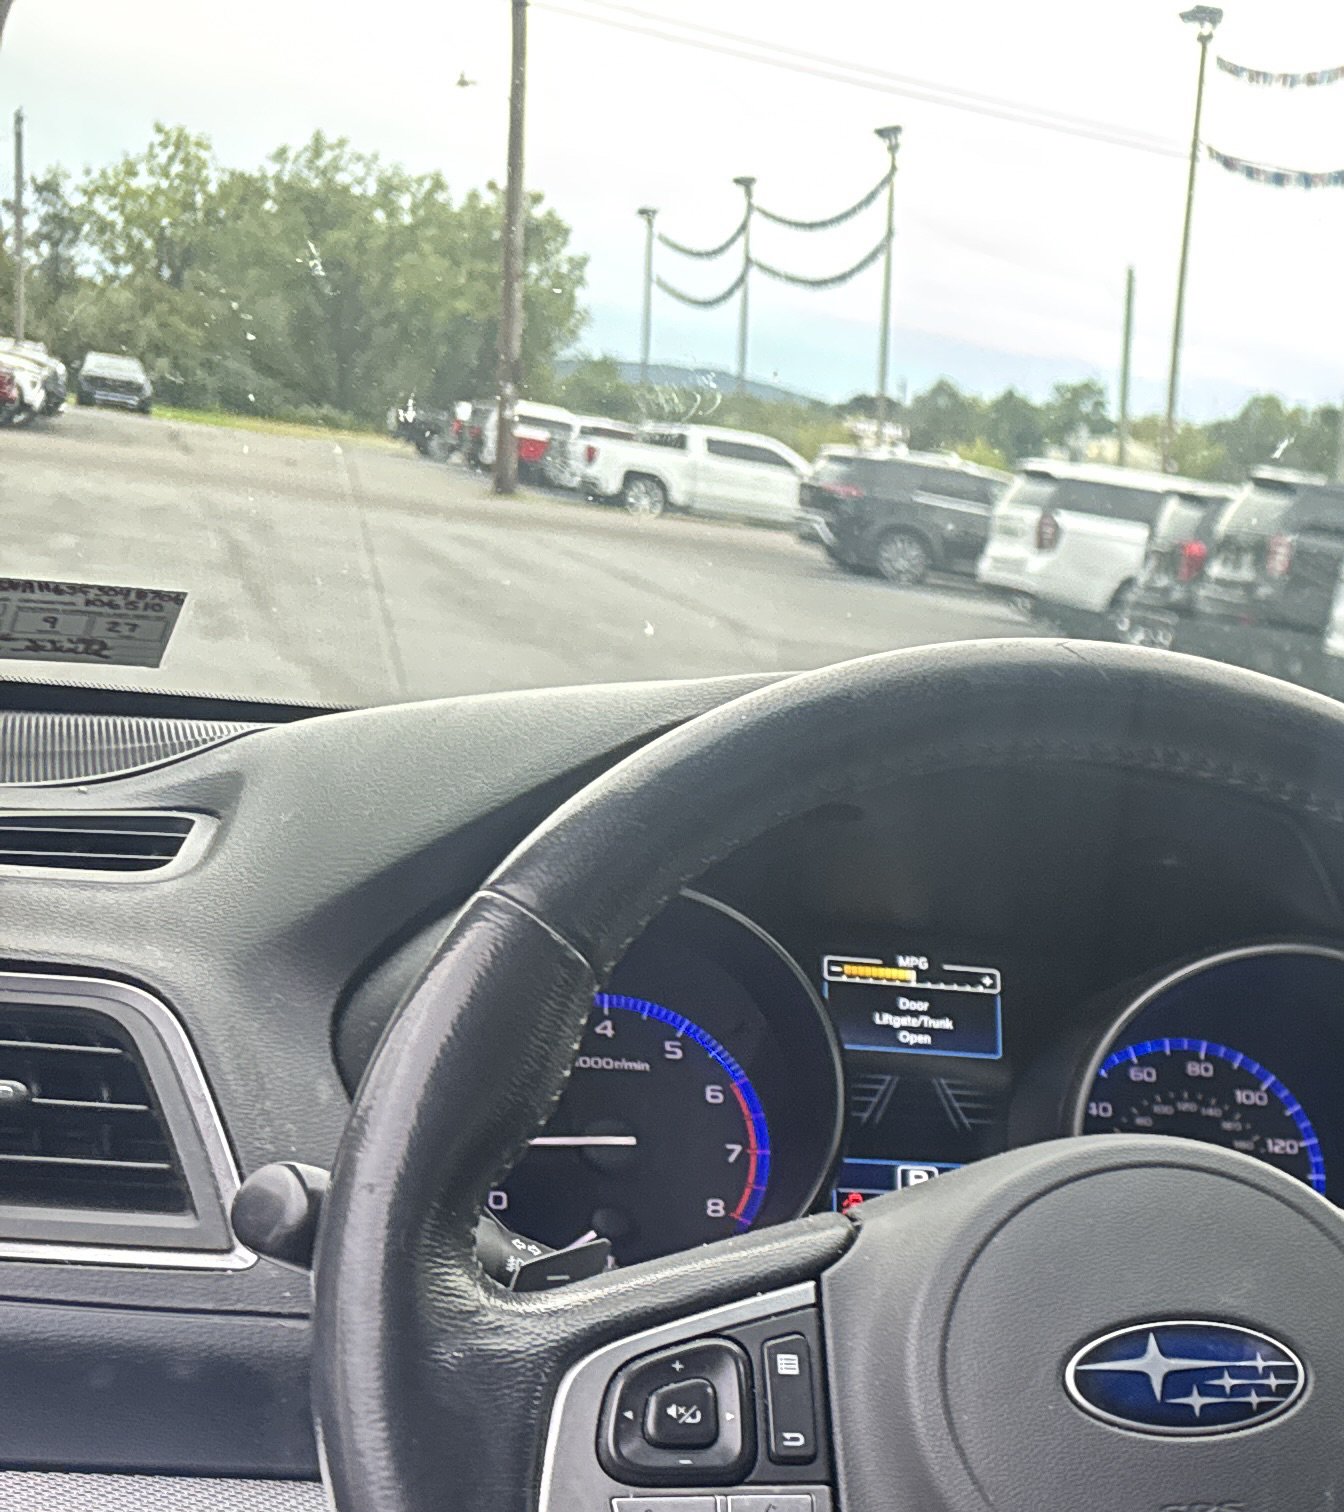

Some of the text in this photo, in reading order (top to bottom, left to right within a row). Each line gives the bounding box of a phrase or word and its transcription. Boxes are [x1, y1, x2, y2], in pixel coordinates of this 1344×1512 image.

[42, 616, 58, 629] 9
[105, 620, 140, 634] 27
[896, 954, 929, 971] MPG
[897, 996, 930, 1012] Door
[594, 1019, 616, 1039] 4
[873, 1012, 954, 1031] Liftgate/Trunk
[897, 1030, 932, 1046] Open
[664, 1040, 683, 1060] 5
[1128, 1066, 1158, 1083] 60
[1185, 1061, 1215, 1078] 80
[705, 1085, 725, 1104] 6
[1234, 1088, 1269, 1107] 100
[1087, 1101, 1113, 1118] 40
[724, 1144, 743, 1163] 7
[1265, 1138, 1300, 1155] 120
[488, 1191, 508, 1210] 0
[706, 1198, 726, 1218] 8
